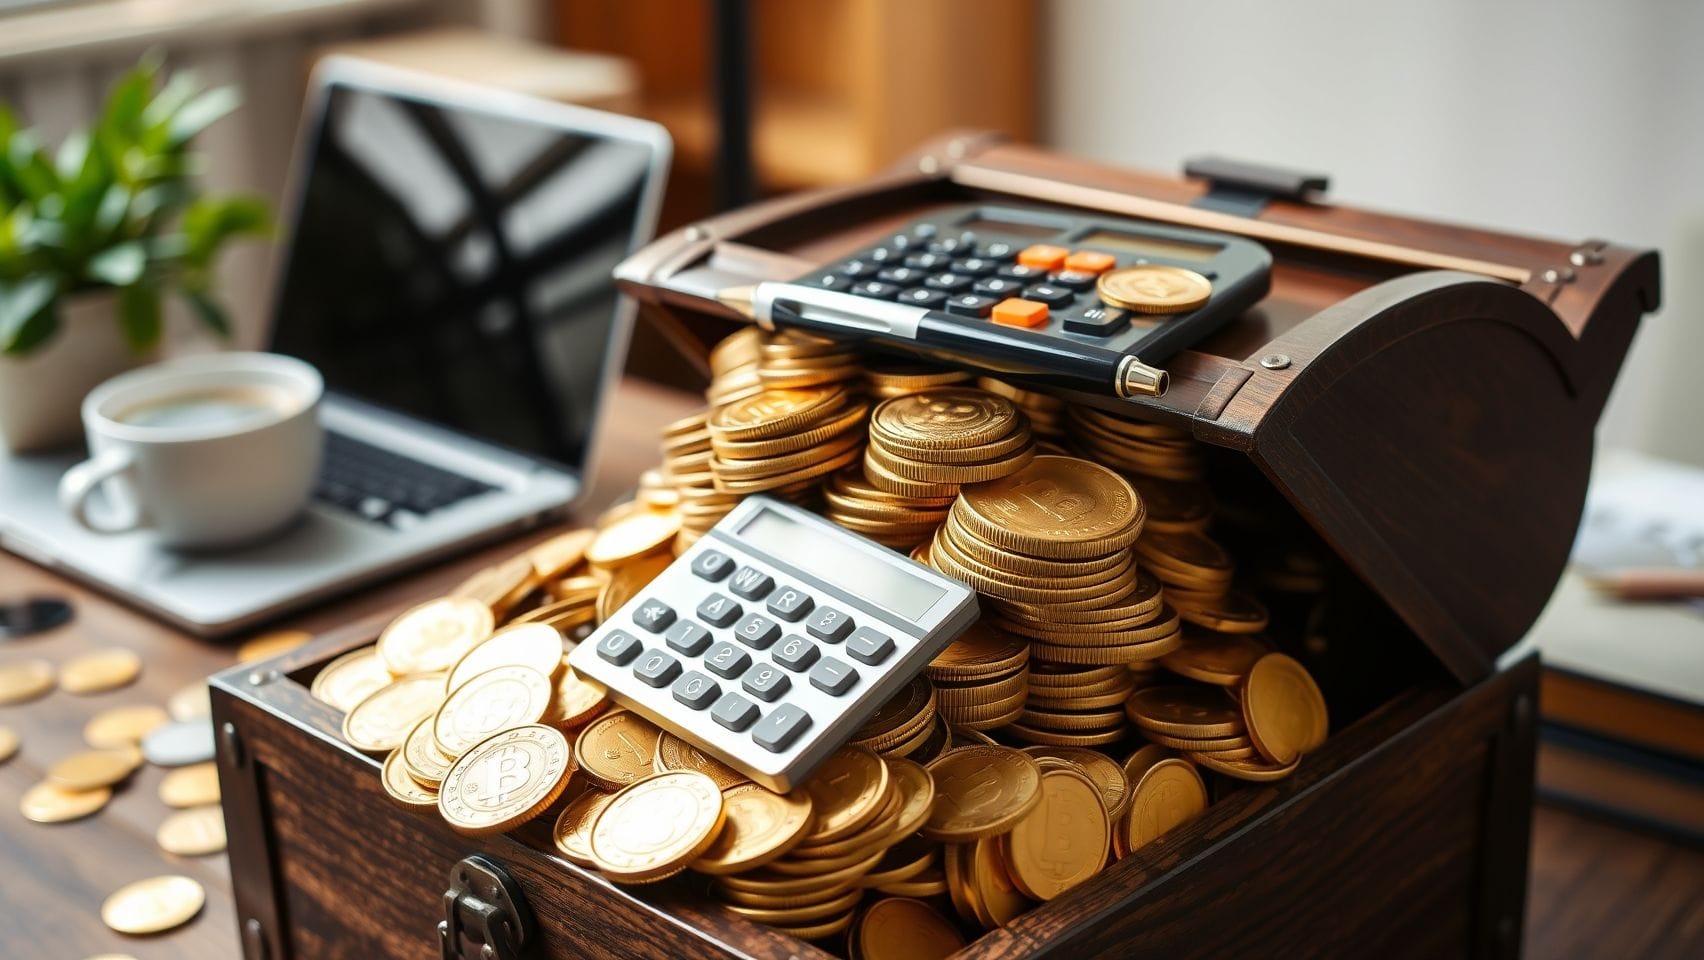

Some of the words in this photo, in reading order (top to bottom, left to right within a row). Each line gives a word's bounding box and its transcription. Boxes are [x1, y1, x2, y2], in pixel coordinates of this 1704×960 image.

[777, 590, 796, 607] R
[681, 626, 693, 640] 1
[713, 648, 733, 663] 2
[784, 639, 802, 656] 6
